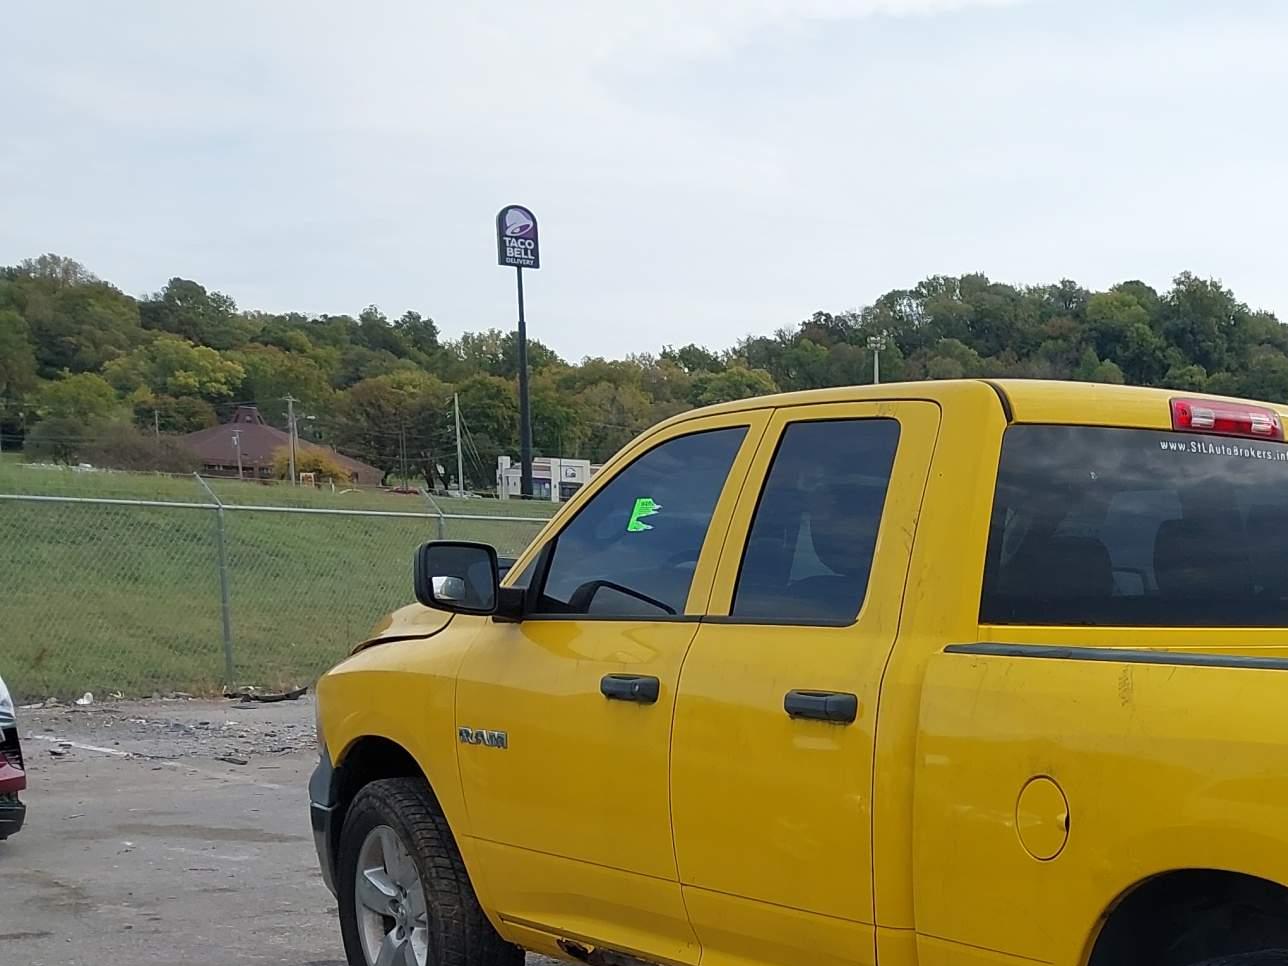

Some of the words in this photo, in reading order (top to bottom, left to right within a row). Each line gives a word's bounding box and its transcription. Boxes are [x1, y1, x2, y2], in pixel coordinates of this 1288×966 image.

[503, 236, 535, 249] TACO
[506, 247, 535, 259] BELL
[459, 727, 508, 749] RAM
